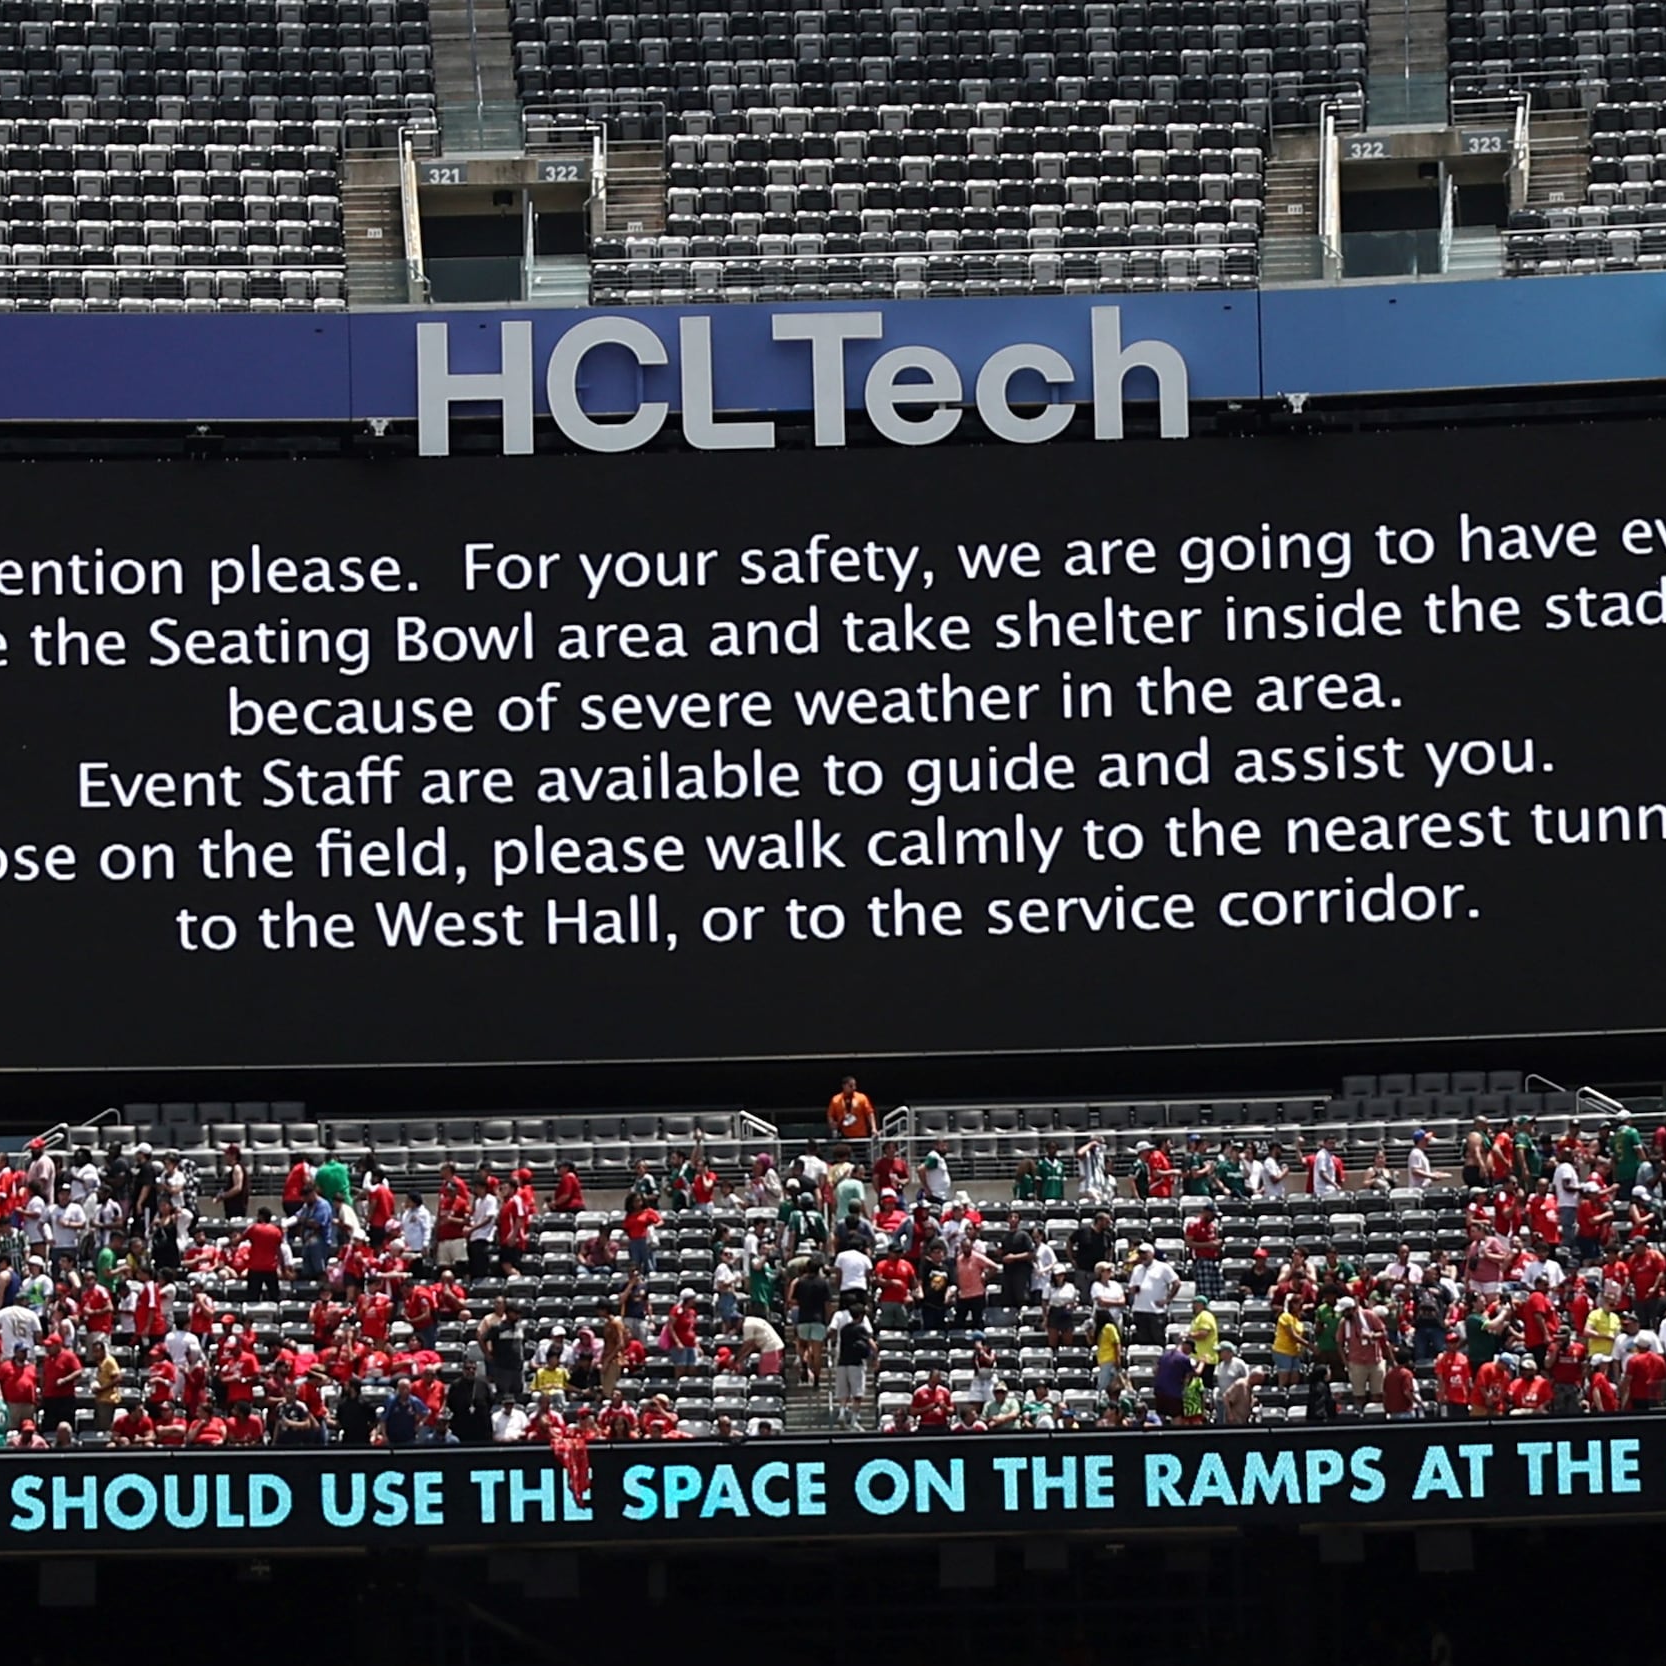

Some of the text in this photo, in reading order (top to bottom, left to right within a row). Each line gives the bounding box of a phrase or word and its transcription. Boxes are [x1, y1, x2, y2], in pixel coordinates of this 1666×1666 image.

[428, 167, 461, 185] 321
[545, 166, 578, 182] 322
[1351, 142, 1384, 159] 322
[1469, 136, 1502, 153] 323
[416, 305, 1192, 457] HCLTech
[211, 543, 418, 606] please.
[465, 542, 561, 591] For
[578, 549, 719, 600] your
[740, 533, 934, 593] safety,
[957, 541, 1041, 579] we
[1064, 538, 1156, 576] are
[1179, 522, 1351, 584] going
[1374, 525, 1435, 565] to
[1460, 512, 1597, 562] have
[29, 616, 126, 667] the
[149, 617, 370, 676] Seating
[397, 610, 534, 662] Bowl
[558, 622, 689, 660] area
[709, 604, 819, 657] and
[842, 602, 971, 653] take
[995, 596, 1202, 650] shelter
[1226, 588, 1403, 641] inside
[1423, 584, 1521, 635] the
[229, 665, 1402, 736] because of severe weather in the area.
[79, 734, 1554, 808] Event Staff are available to guide and assist you.
[99, 843, 175, 881] on
[198, 828, 294, 879] the
[315, 826, 467, 885] field,
[494, 824, 685, 887] please
[705, 818, 846, 871] walk
[867, 813, 1064, 874] calmly
[1082, 819, 1144, 861] to
[1164, 807, 1262, 858] the
[1287, 805, 1511, 854] nearest
[175, 871, 1479, 951] to the West Hall, or to the service corridor.
[11, 1474, 292, 1531] SHOULD
[322, 1471, 443, 1527] USE
[623, 1462, 826, 1520] SPACE
[855, 1459, 965, 1514] ON
[993, 1455, 1114, 1510] THE
[1145, 1447, 1385, 1506] RAMPS
[1412, 1444, 1493, 1499] AT
[1517, 1439, 1640, 1495] THE
